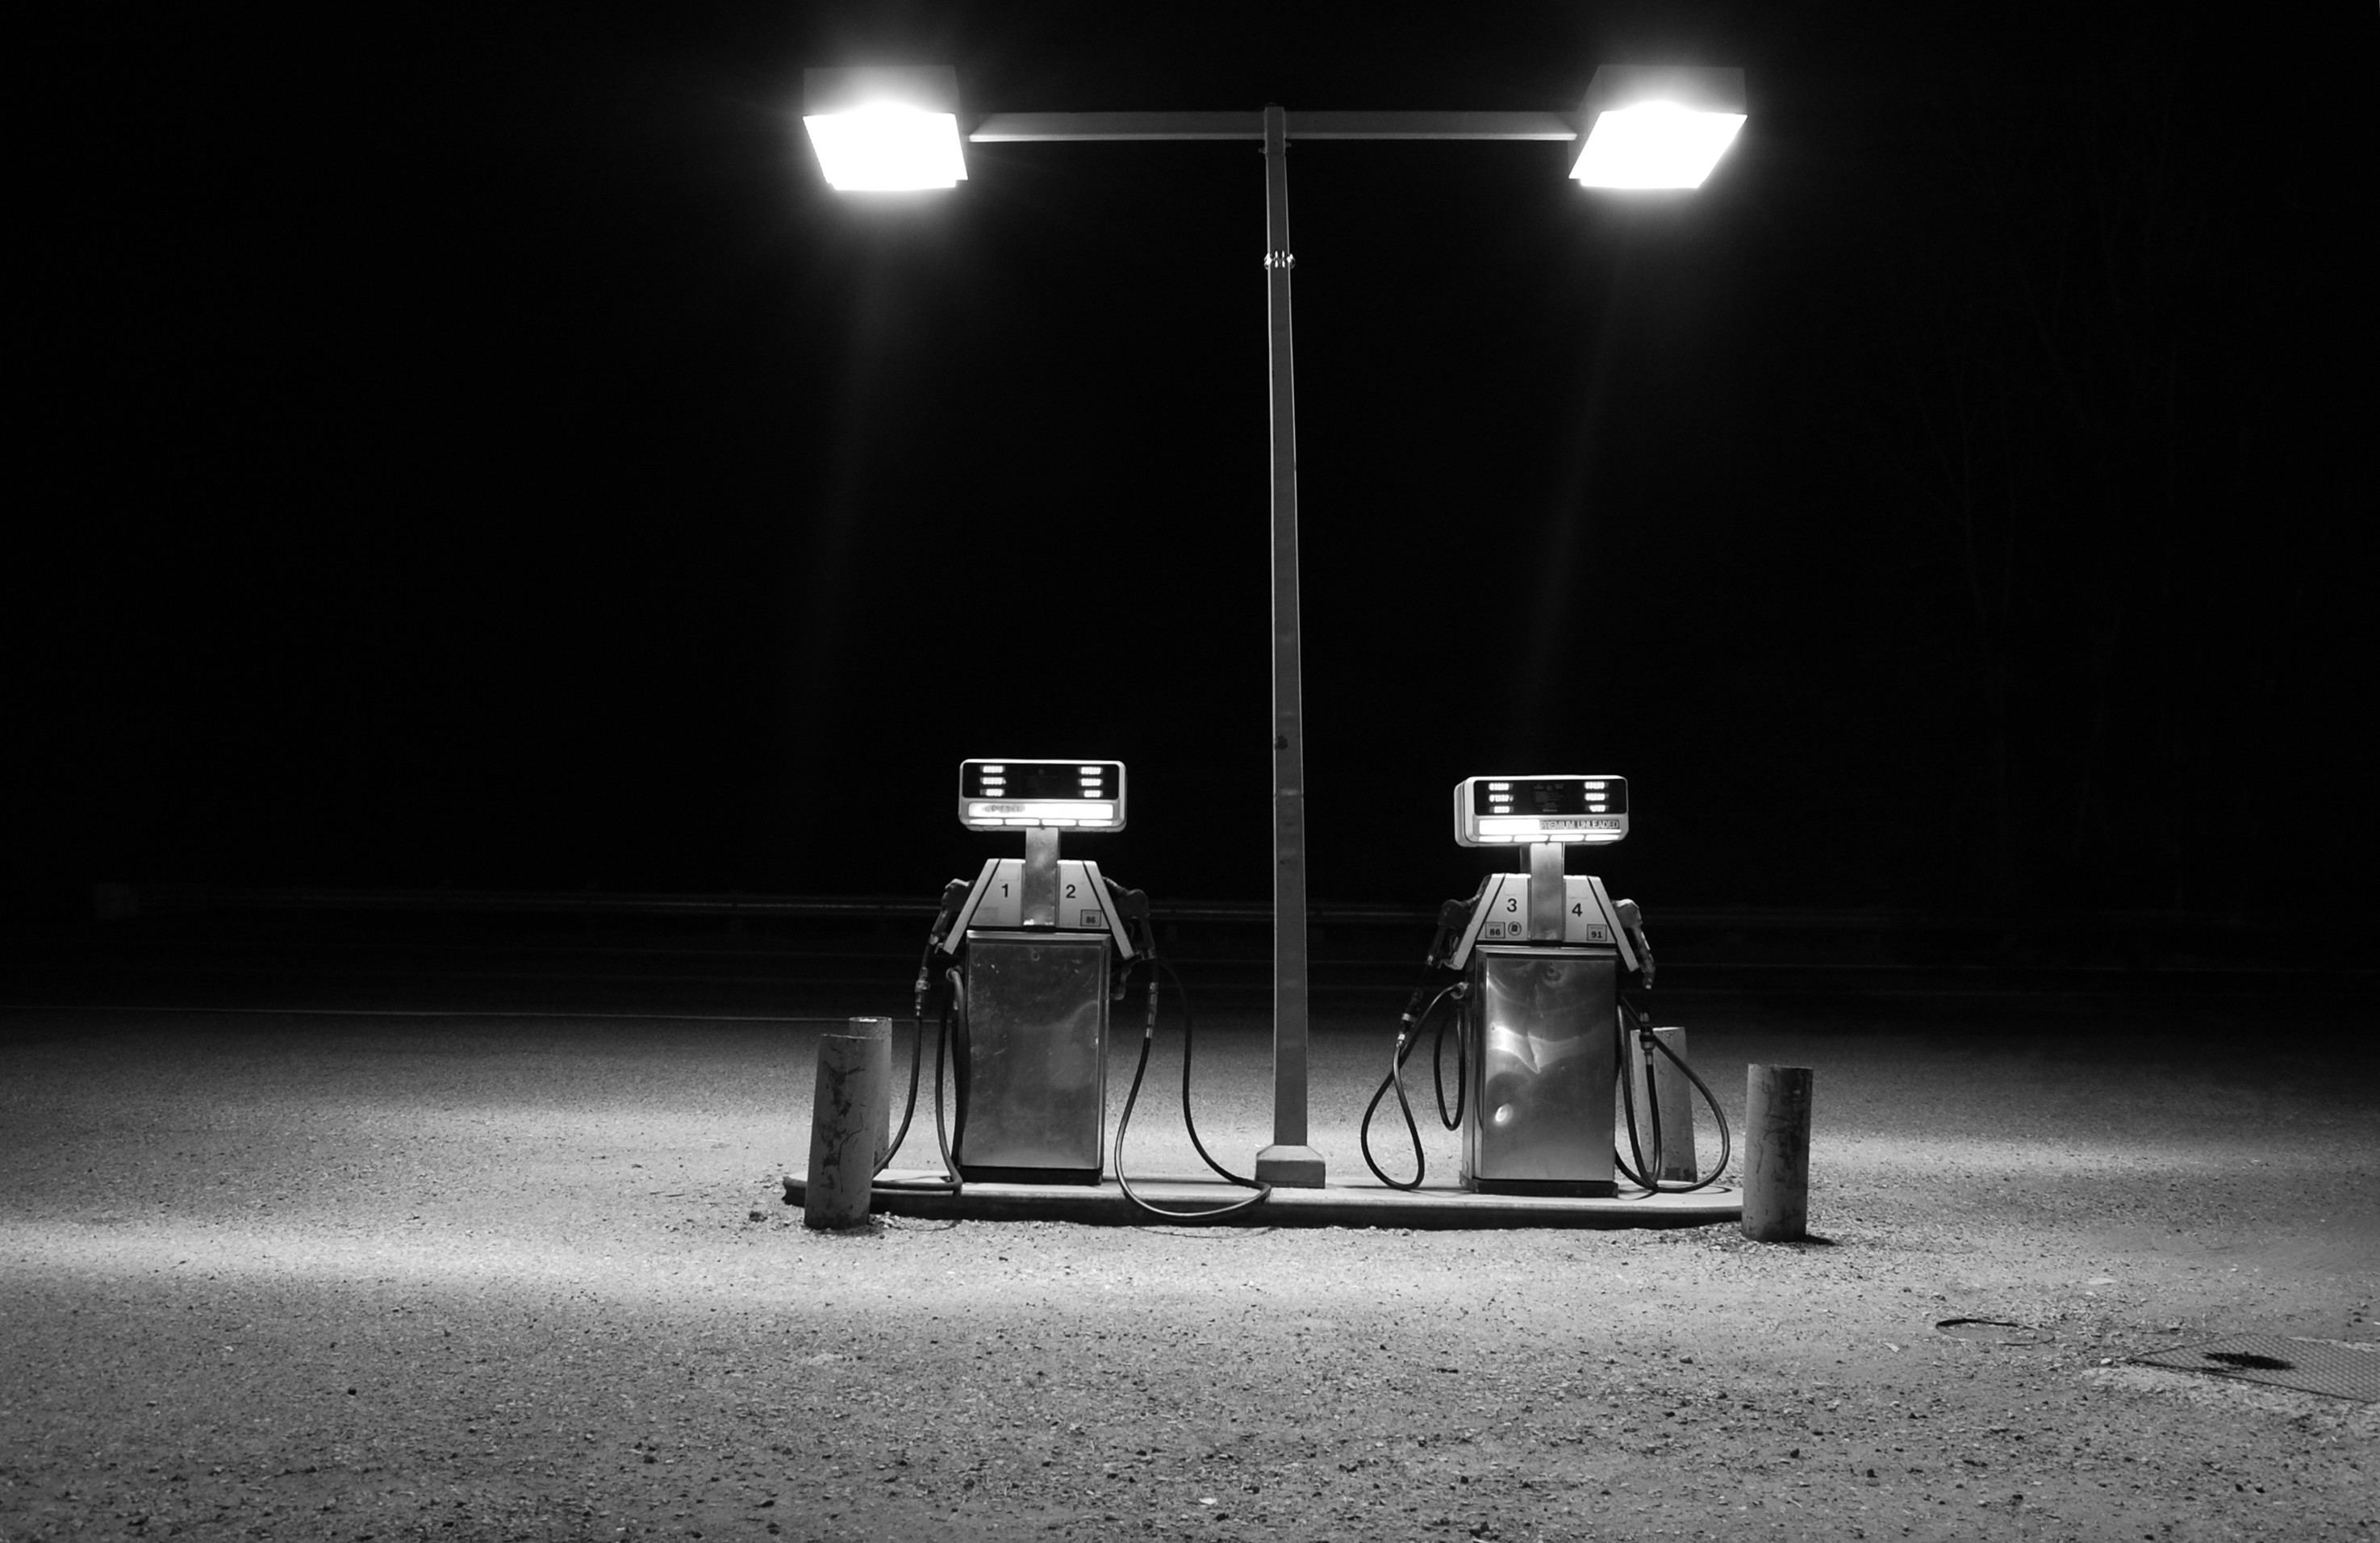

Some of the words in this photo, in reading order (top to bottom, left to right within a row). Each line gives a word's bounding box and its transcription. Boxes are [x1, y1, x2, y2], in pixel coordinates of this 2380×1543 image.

[1541, 820, 1575, 829] PREMIUM
[1577, 820, 1619, 829] UNLEADED
[1001, 884, 1008, 897] 1
[1066, 884, 1076, 898] 2
[1506, 898, 1518, 913] 3
[1572, 903, 1583, 917] 4
[1489, 928, 1501, 936] 86
[1591, 930, 1602, 939] 91
